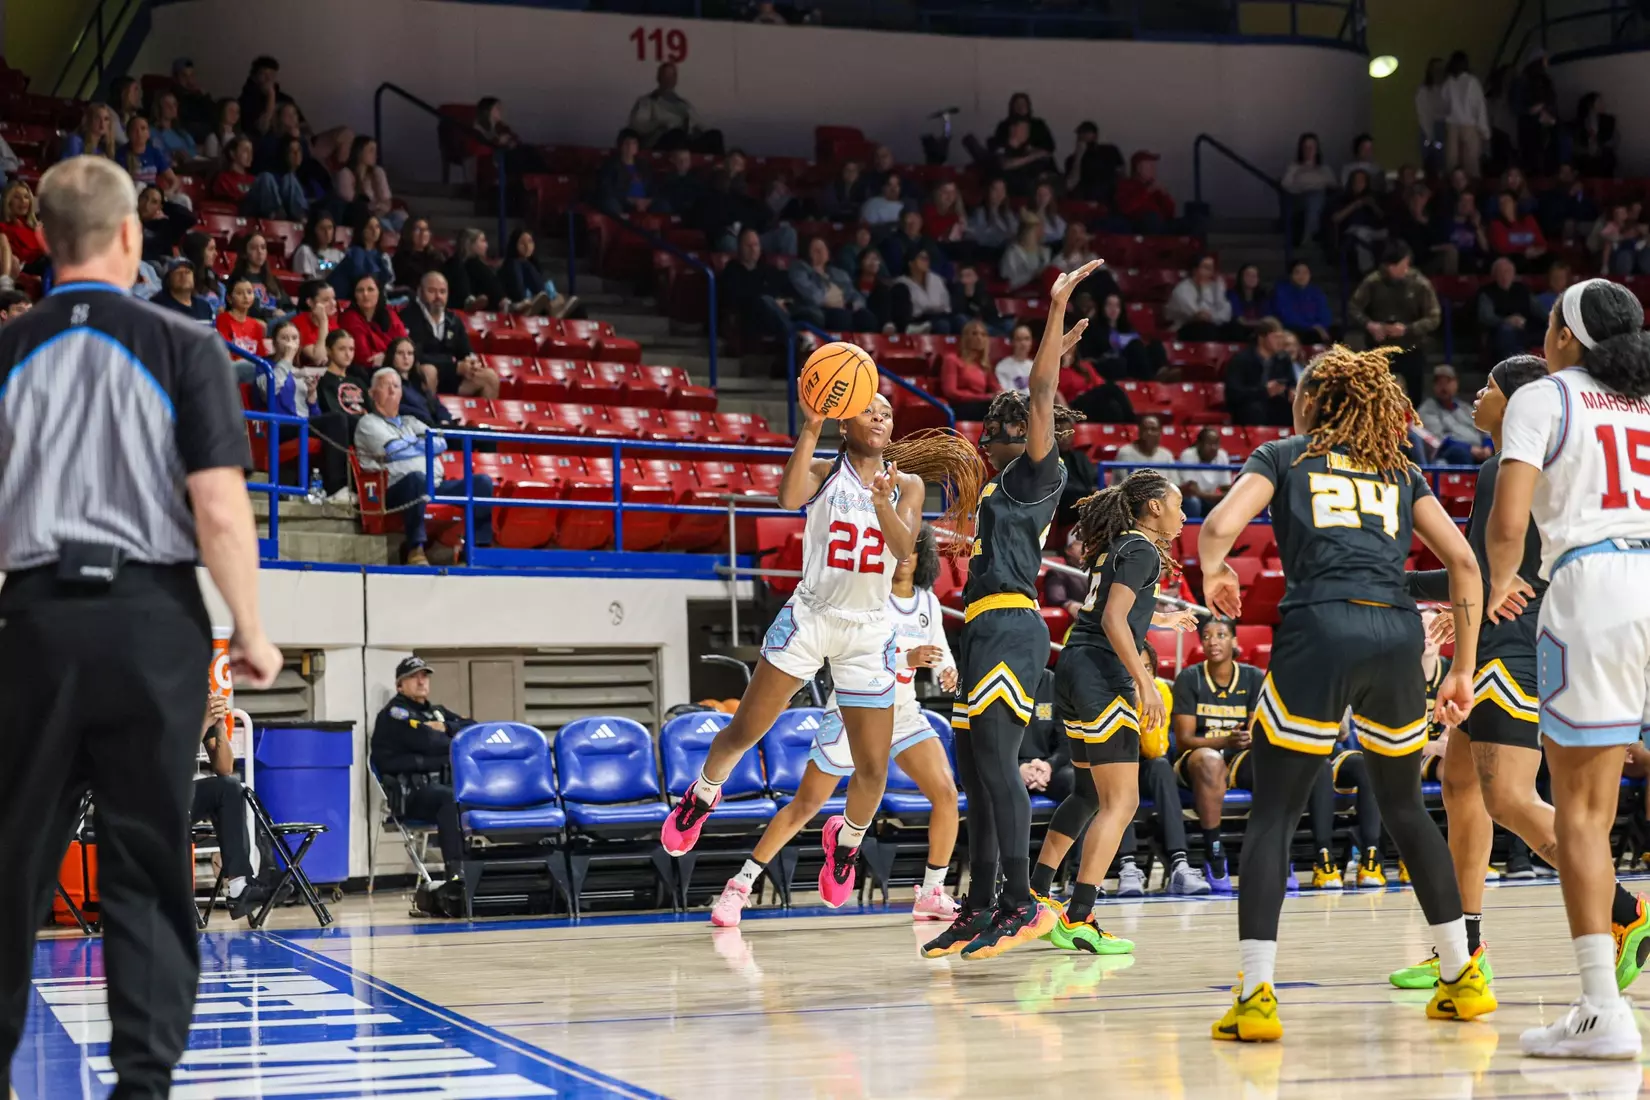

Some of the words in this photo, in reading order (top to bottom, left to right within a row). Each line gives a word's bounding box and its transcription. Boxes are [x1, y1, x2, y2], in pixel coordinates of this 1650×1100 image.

[629, 25, 688, 63] 119
[1580, 391, 1650, 415] MARSHA
[1595, 424, 1650, 511] 15
[1308, 472, 1399, 540] 24
[827, 520, 885, 575] 22
